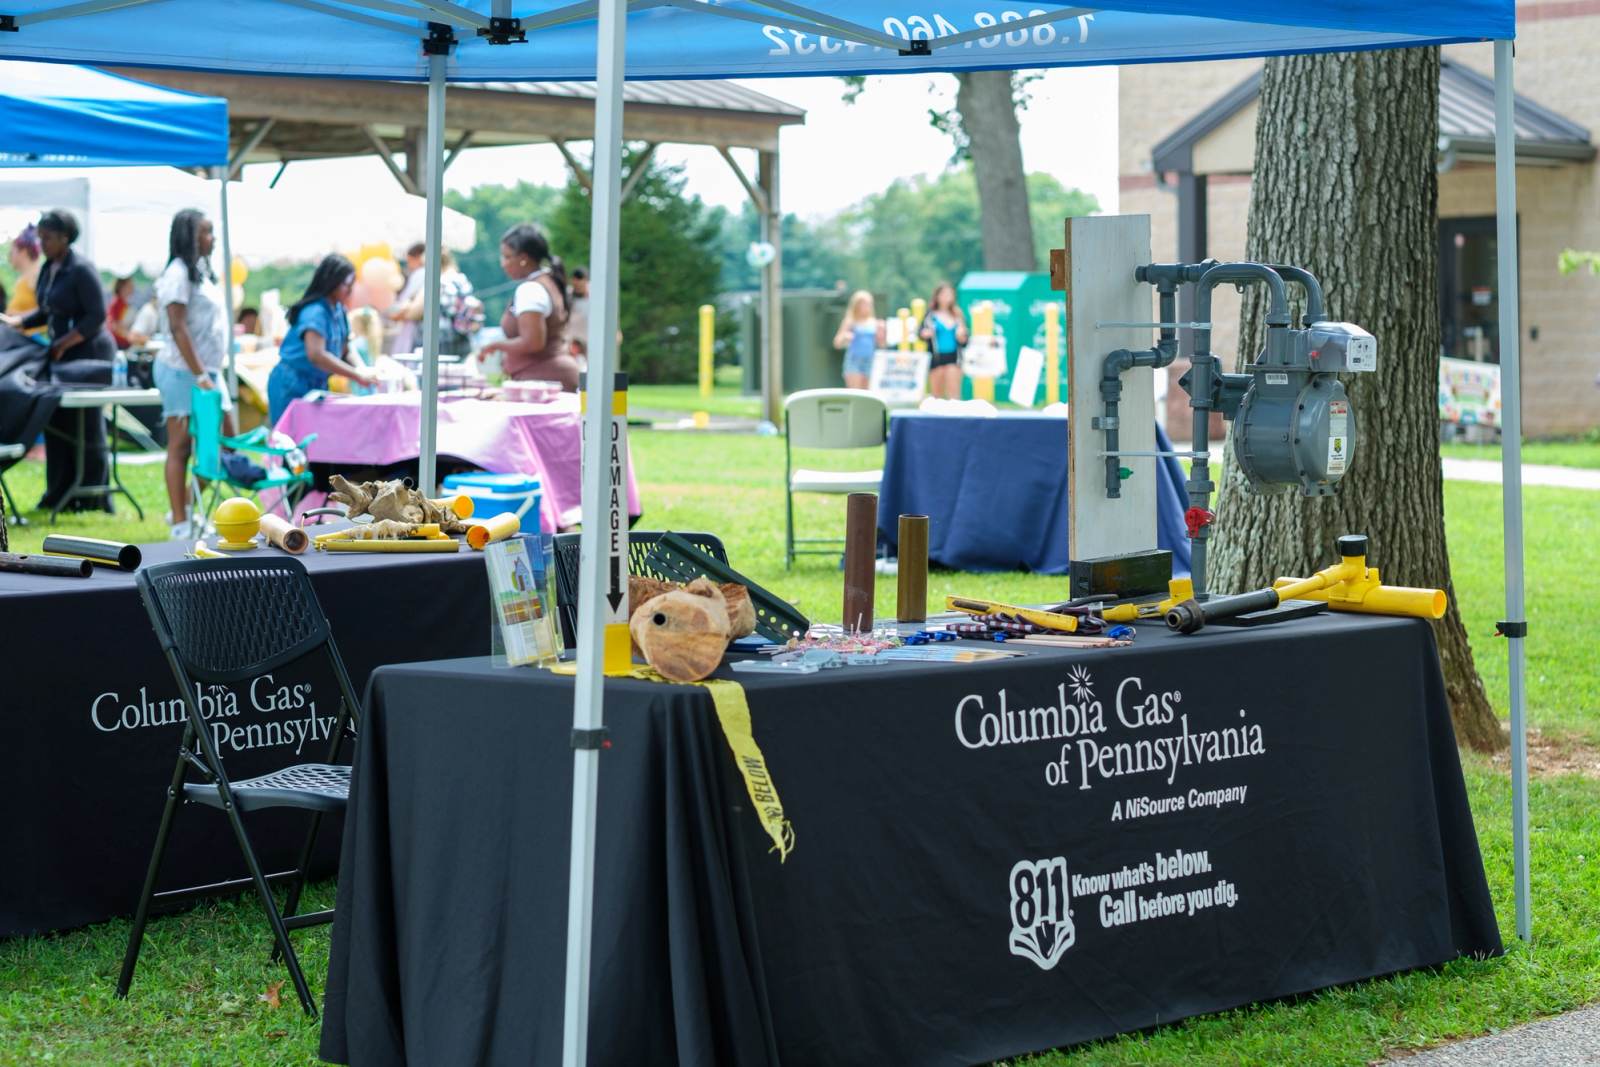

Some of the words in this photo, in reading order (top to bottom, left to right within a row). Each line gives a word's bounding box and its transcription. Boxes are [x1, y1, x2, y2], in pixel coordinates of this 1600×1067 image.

[609, 421, 622, 553] DAMAGE
[954, 682, 1107, 749] Columbia
[1045, 743, 1072, 786] of
[1076, 708, 1266, 790] Pennsylvania
[741, 754, 775, 804] BELOW
[1111, 800, 1123, 821] A
[1125, 794, 1185, 819] NiSource
[1188, 784, 1248, 810] Company
[1012, 860, 1067, 929] 811
[1071, 872, 1110, 898] Know
[1111, 862, 1155, 890] what's
[1155, 849, 1212, 882] below.
[1099, 889, 1137, 928] Call
[1138, 891, 1185, 921] before
[1186, 887, 1213, 917] you
[1213, 879, 1239, 908] dig.
